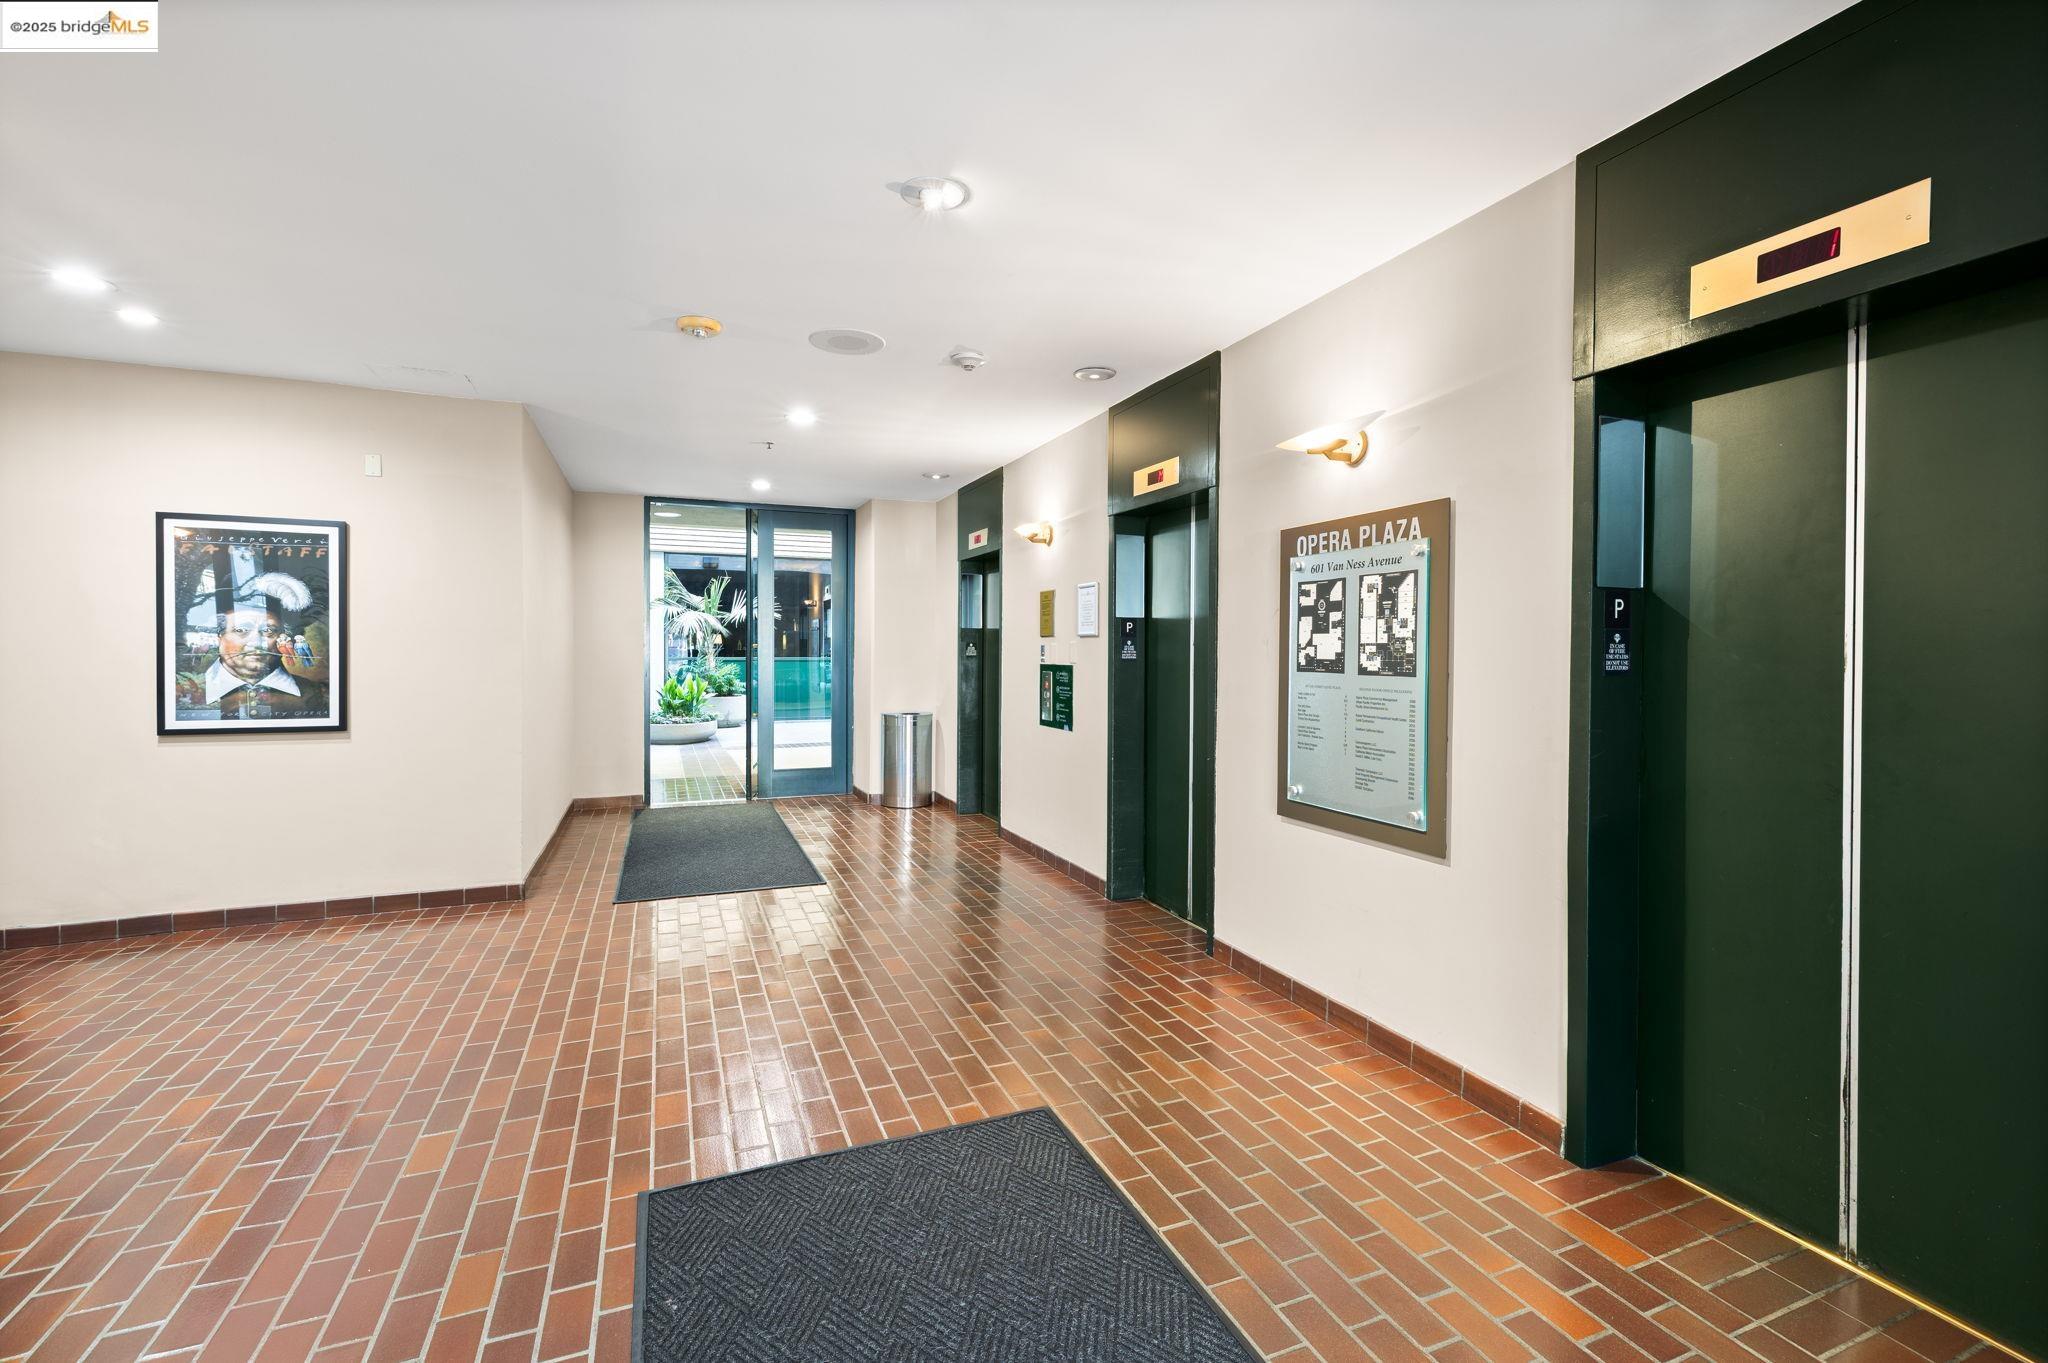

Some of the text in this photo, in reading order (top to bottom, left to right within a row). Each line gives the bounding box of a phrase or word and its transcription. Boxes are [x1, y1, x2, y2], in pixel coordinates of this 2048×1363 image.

[1296, 516, 1422, 557] OPERA PLAZA
[1310, 555, 1403, 575] 601 Van Ness Avenue
[1614, 598, 1625, 619] P
[1126, 622, 1133, 633] P
